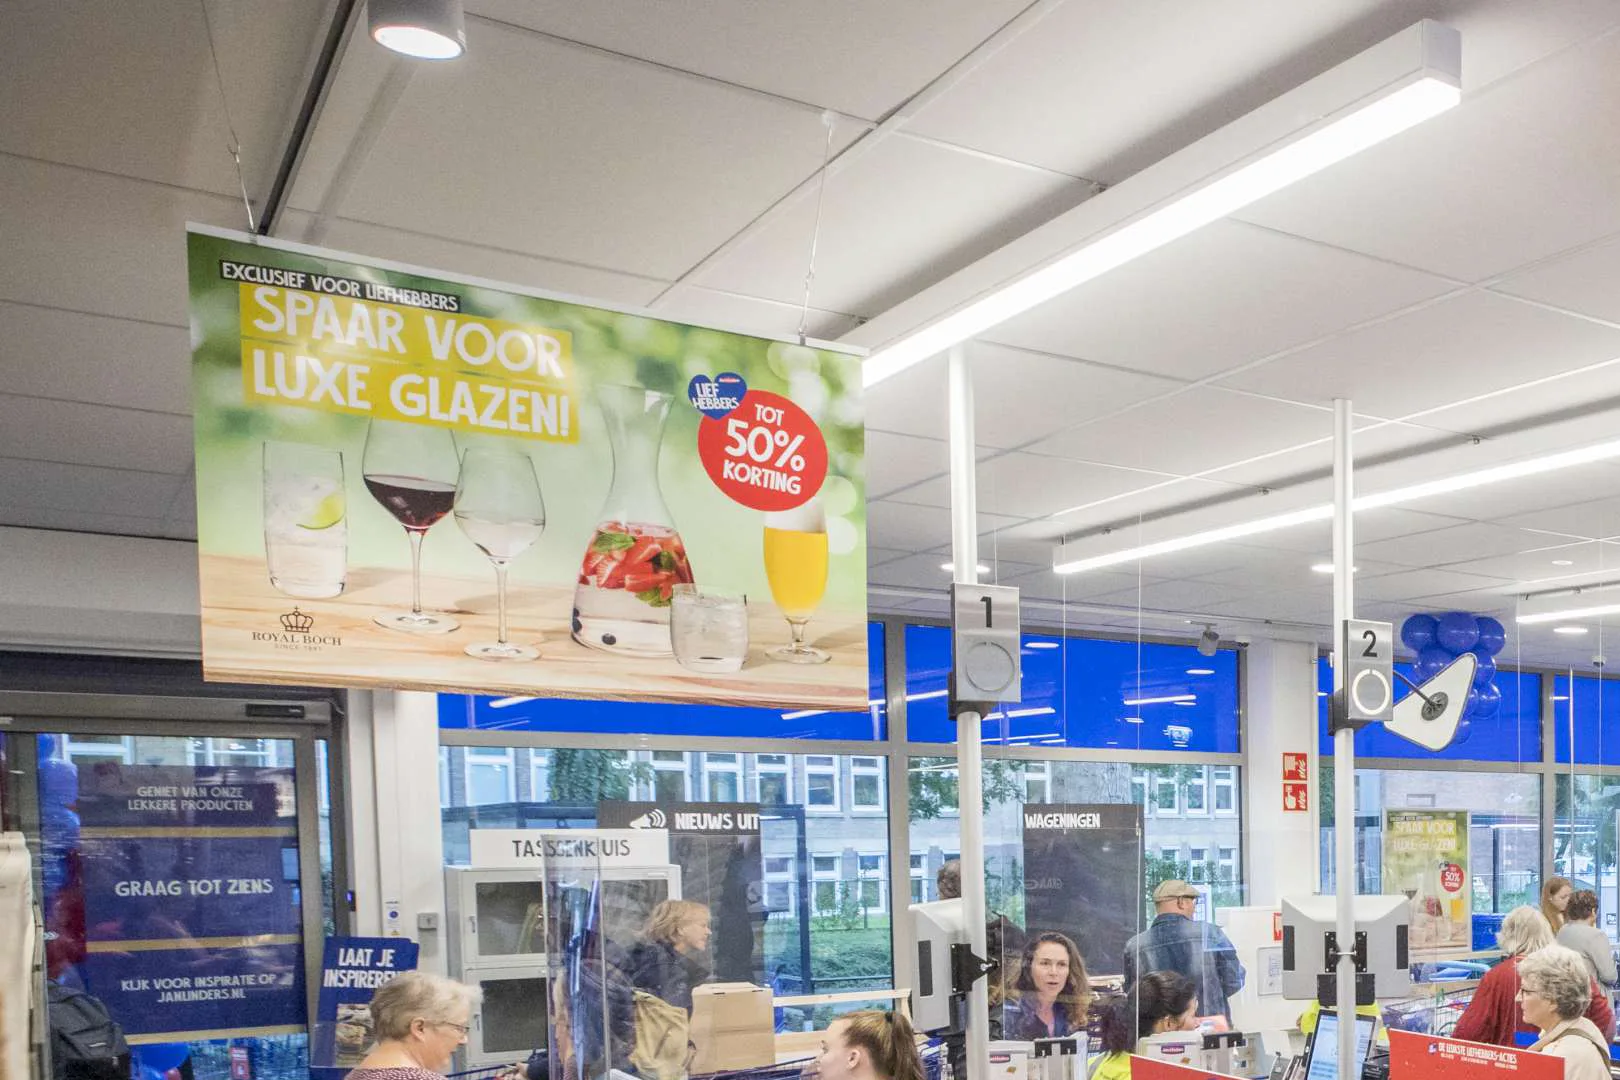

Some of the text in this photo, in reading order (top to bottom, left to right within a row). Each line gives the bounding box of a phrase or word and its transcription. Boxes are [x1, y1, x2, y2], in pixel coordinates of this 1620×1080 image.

[222, 262, 458, 312] EXCLUSIEF VOOR LIEFHEBBERS
[253, 286, 565, 379] SPAAR VOOR
[253, 349, 570, 437] LUXE GLAZEN!
[695, 383, 719, 398] LIEF
[692, 397, 740, 410] HEBBERS
[755, 403, 784, 426] TOT
[724, 418, 806, 472] 50%
[723, 459, 801, 495] KORTING
[980, 596, 993, 629] 1
[252, 631, 342, 646] ROYAL BOCH
[1362, 629, 1378, 658] 2
[136, 786, 244, 798] GENIET VAN ONZE
[128, 799, 253, 811] LEKKERE PRODUCTEN
[675, 812, 760, 830] NIEUWS UIT
[1024, 813, 1100, 829] WAGENINGEN
[115, 879, 273, 897] GRAAG TOT ZIENS
[338, 947, 396, 968] LAAT JE
[153, 977, 191, 990] VOOR
[194, 974, 256, 988] INSPIRATIE
[258, 973, 277, 985] OP
